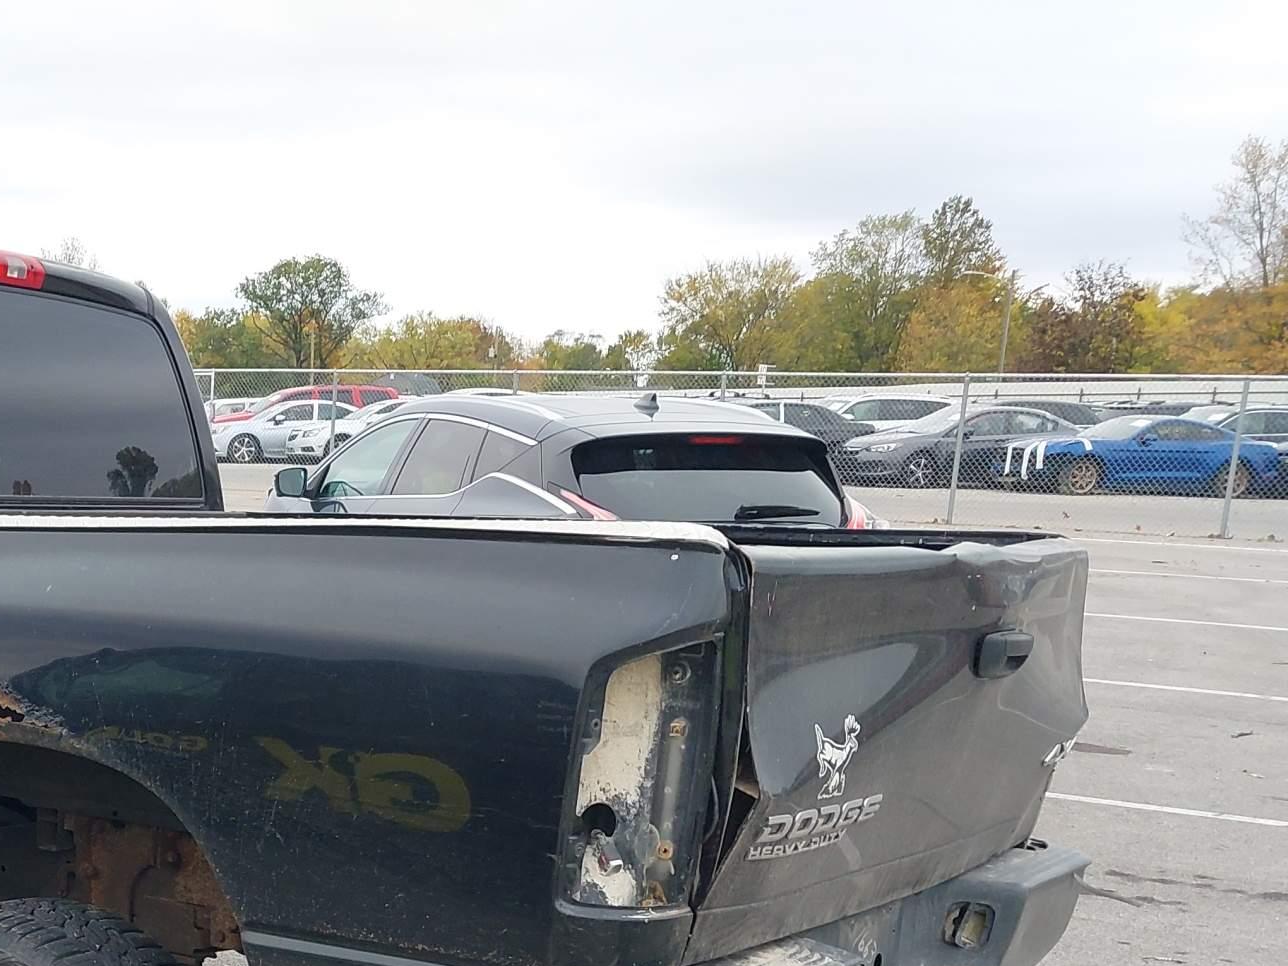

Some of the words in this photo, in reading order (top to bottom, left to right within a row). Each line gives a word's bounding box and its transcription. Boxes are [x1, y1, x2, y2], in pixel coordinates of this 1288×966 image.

[755, 794, 884, 843] DODGE
[746, 840, 807, 861] HEAVY
[810, 828, 848, 848] DUTY
